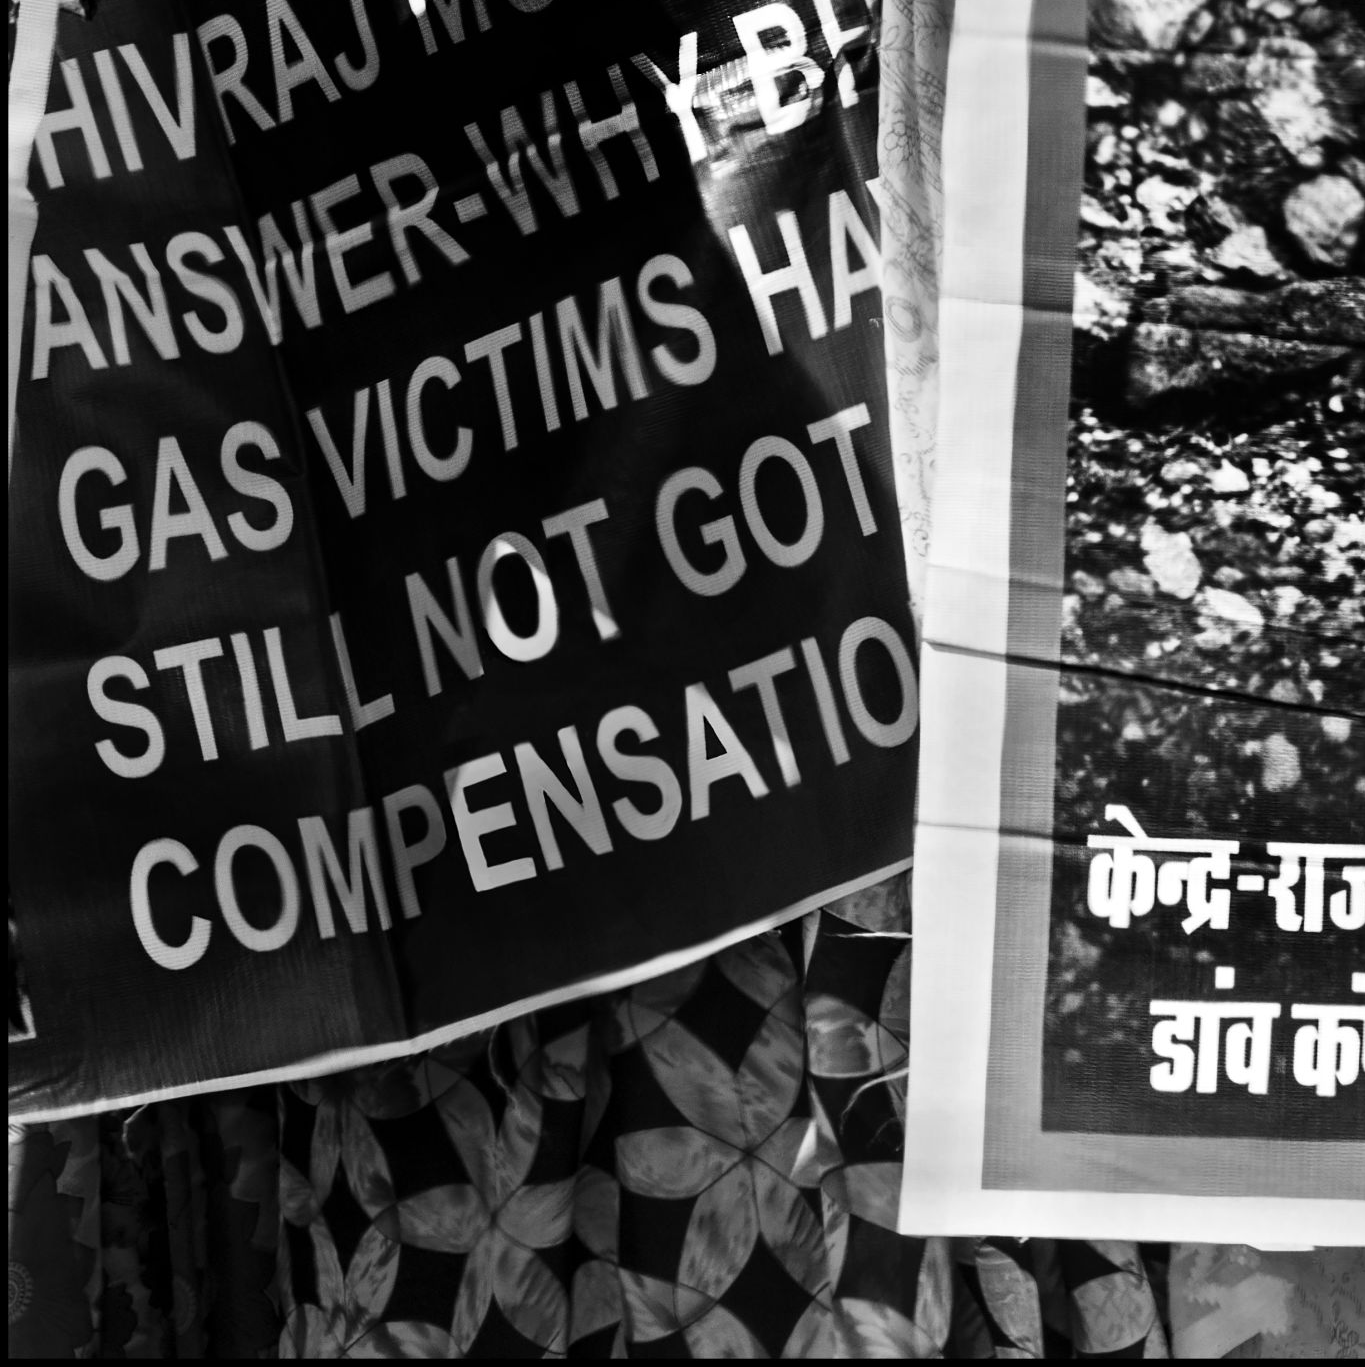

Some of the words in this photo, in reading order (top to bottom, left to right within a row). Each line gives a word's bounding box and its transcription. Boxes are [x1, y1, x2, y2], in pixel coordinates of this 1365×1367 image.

[58, 420, 294, 580] GAS
[307, 253, 717, 521] VICTIMS
[86, 612, 395, 778] STILL
[404, 498, 619, 698] NOT
[655, 402, 878, 598] GOT
[130, 616, 920, 970] COMPENSATIO
[1150, 966, 1281, 1094] डांव
